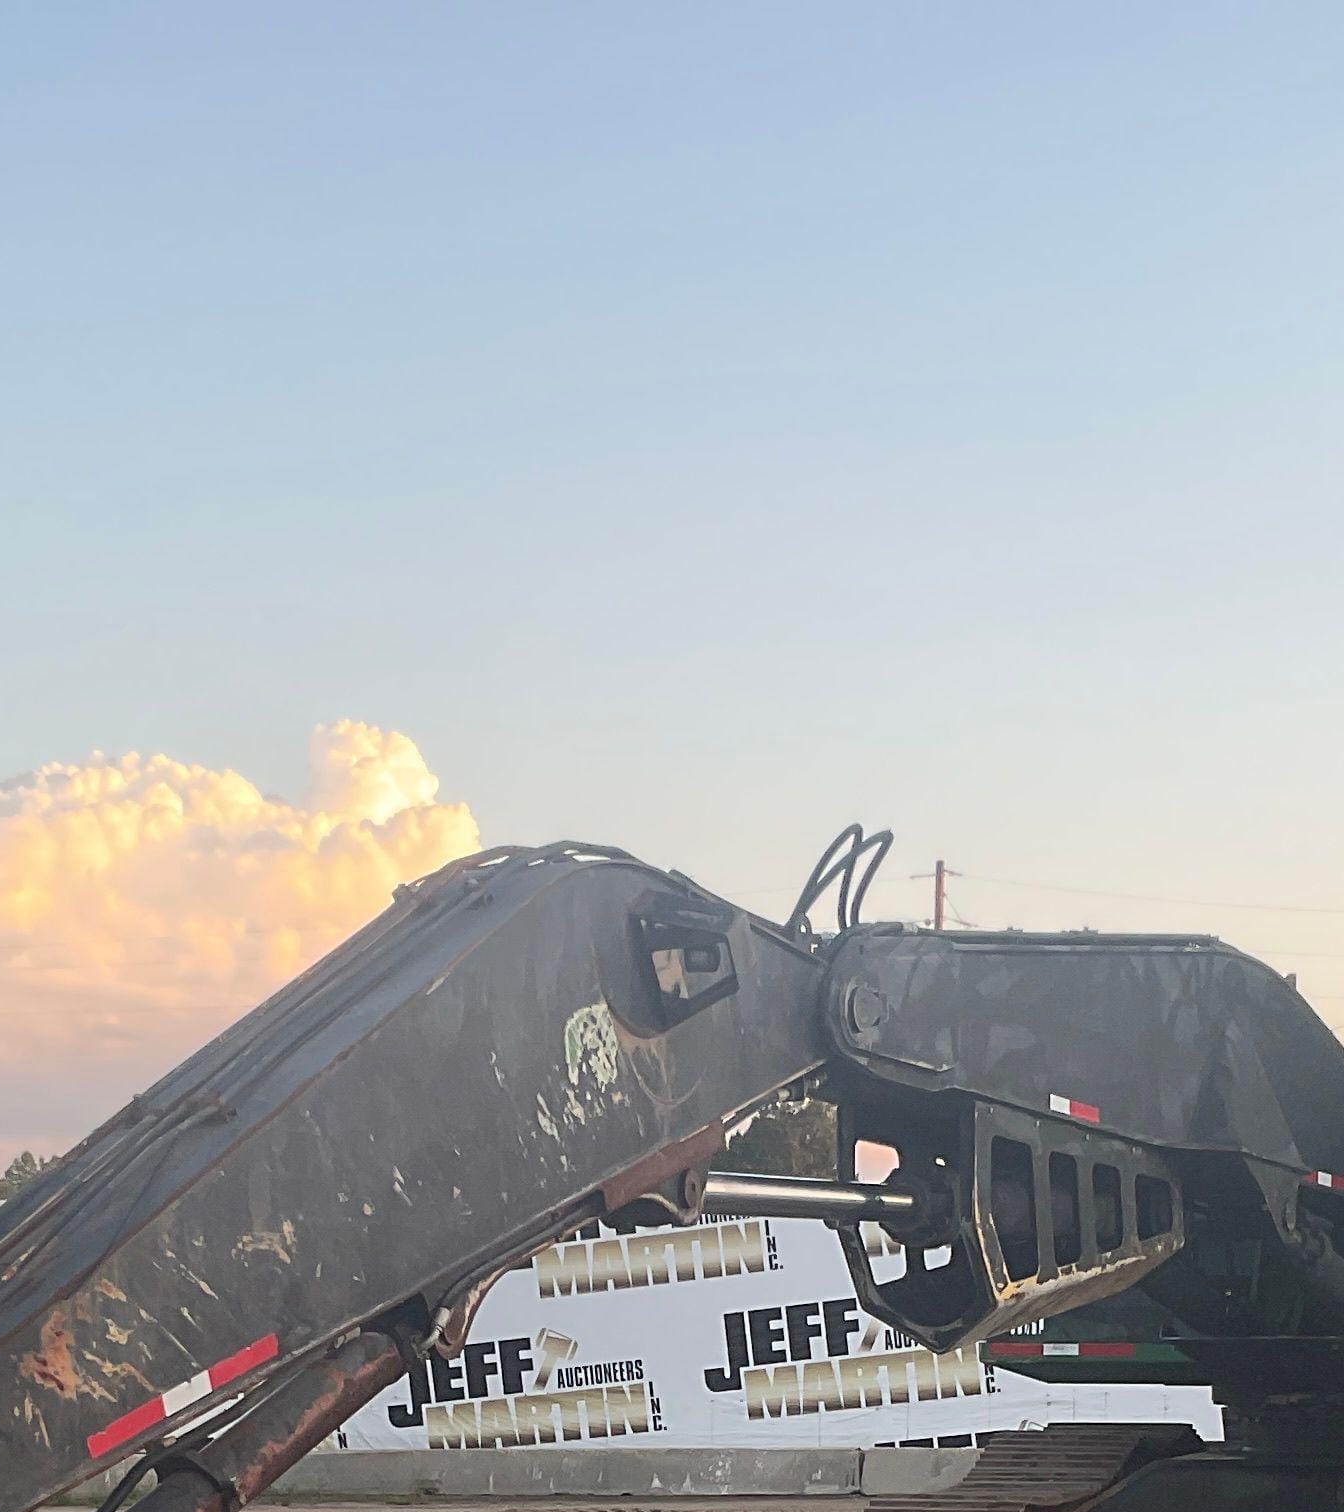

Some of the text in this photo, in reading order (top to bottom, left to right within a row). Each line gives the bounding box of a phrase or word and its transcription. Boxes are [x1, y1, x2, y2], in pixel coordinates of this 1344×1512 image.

[536, 1222, 764, 1299] MARTIN
[388, 1338, 534, 1428] JEFF
[557, 1360, 644, 1389] AUCTIONEERS
[704, 1298, 859, 1392] JEFF
[744, 1343, 981, 1420] MARTIN
[426, 1383, 649, 1449] MARTIN
